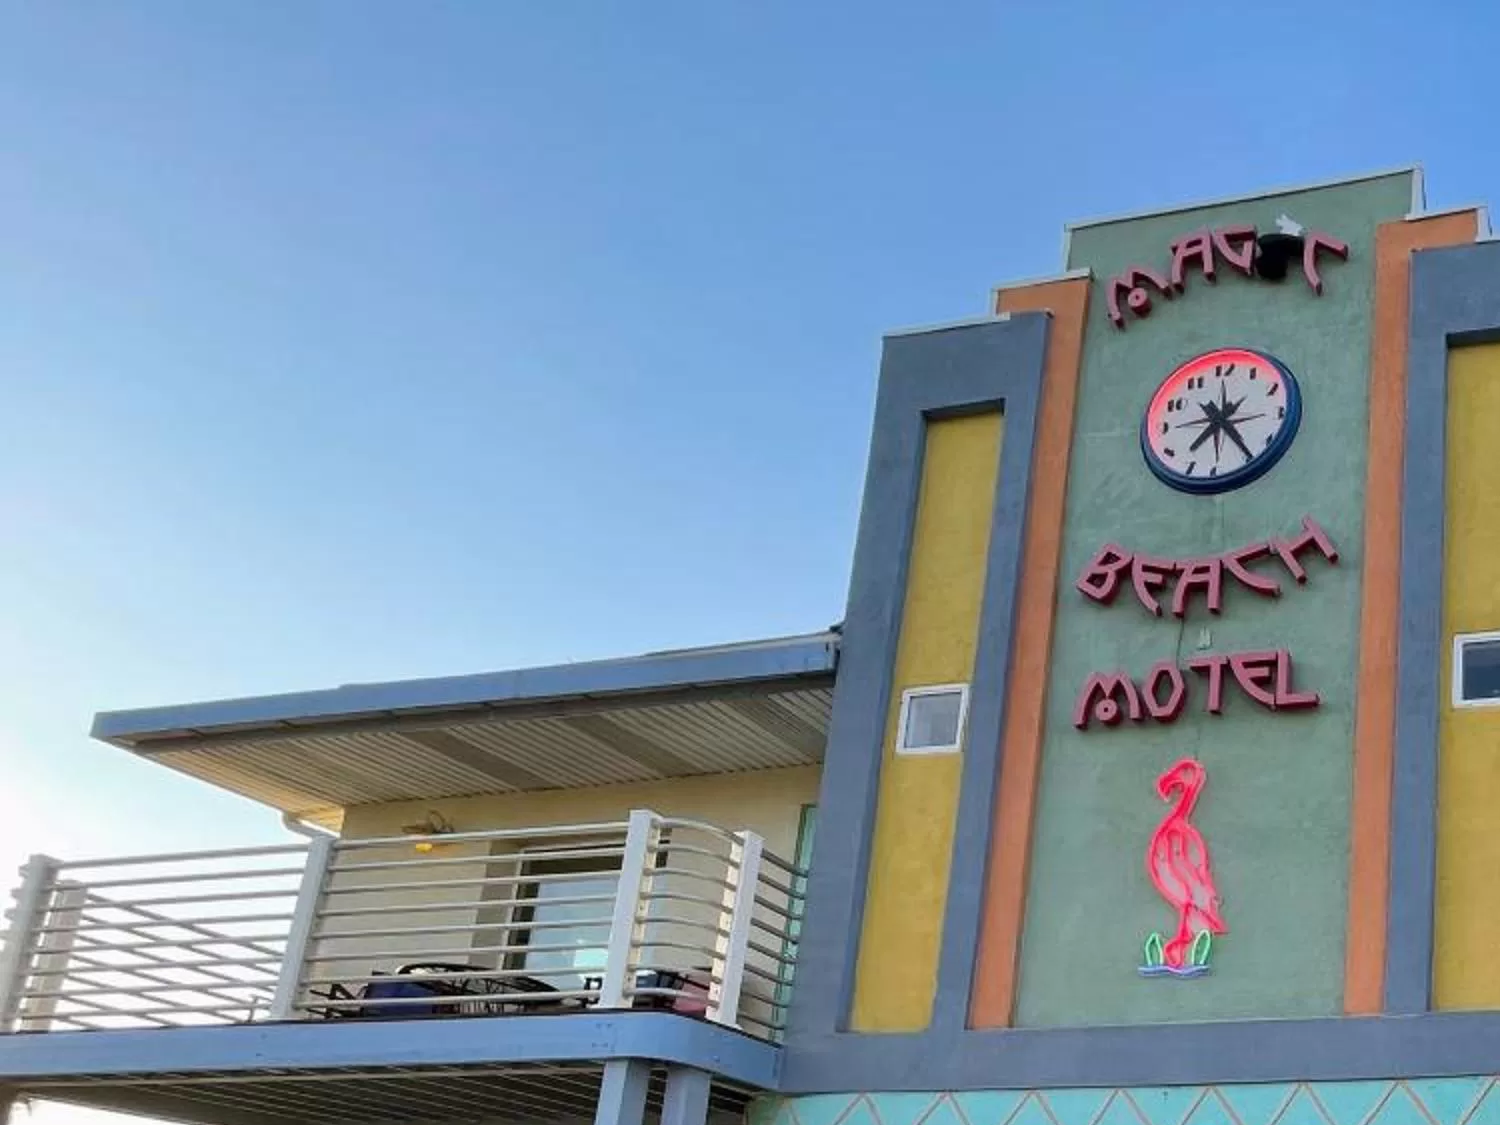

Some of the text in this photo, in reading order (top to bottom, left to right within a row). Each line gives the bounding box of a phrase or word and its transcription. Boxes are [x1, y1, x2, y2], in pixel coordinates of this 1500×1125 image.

[1106, 224, 1349, 330] MAGC
[1075, 515, 1339, 617] BEACH
[1073, 648, 1320, 730] MOTEL
